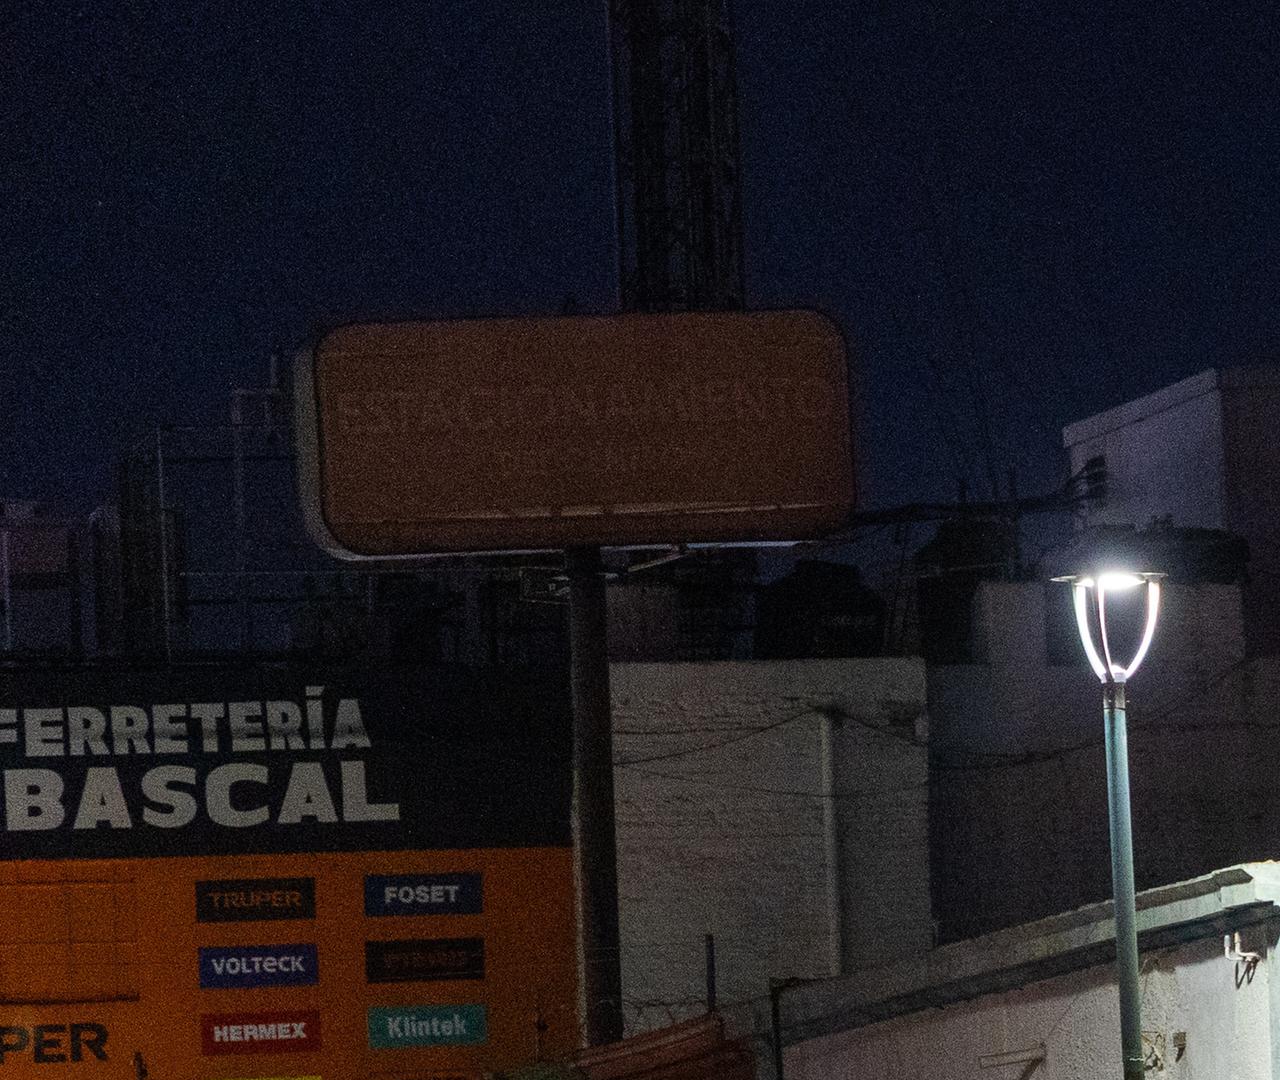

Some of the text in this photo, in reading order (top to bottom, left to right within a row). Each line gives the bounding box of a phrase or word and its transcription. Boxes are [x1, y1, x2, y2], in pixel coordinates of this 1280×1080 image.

[336, 375, 836, 433] ESTACIONAMIENTO
[4, 760, 400, 831] BASCAL
[208, 890, 302, 908] TRUPER
[384, 885, 460, 904] FOSET
[213, 1022, 308, 1042] HERMEX
[387, 1014, 467, 1038] Klintek
